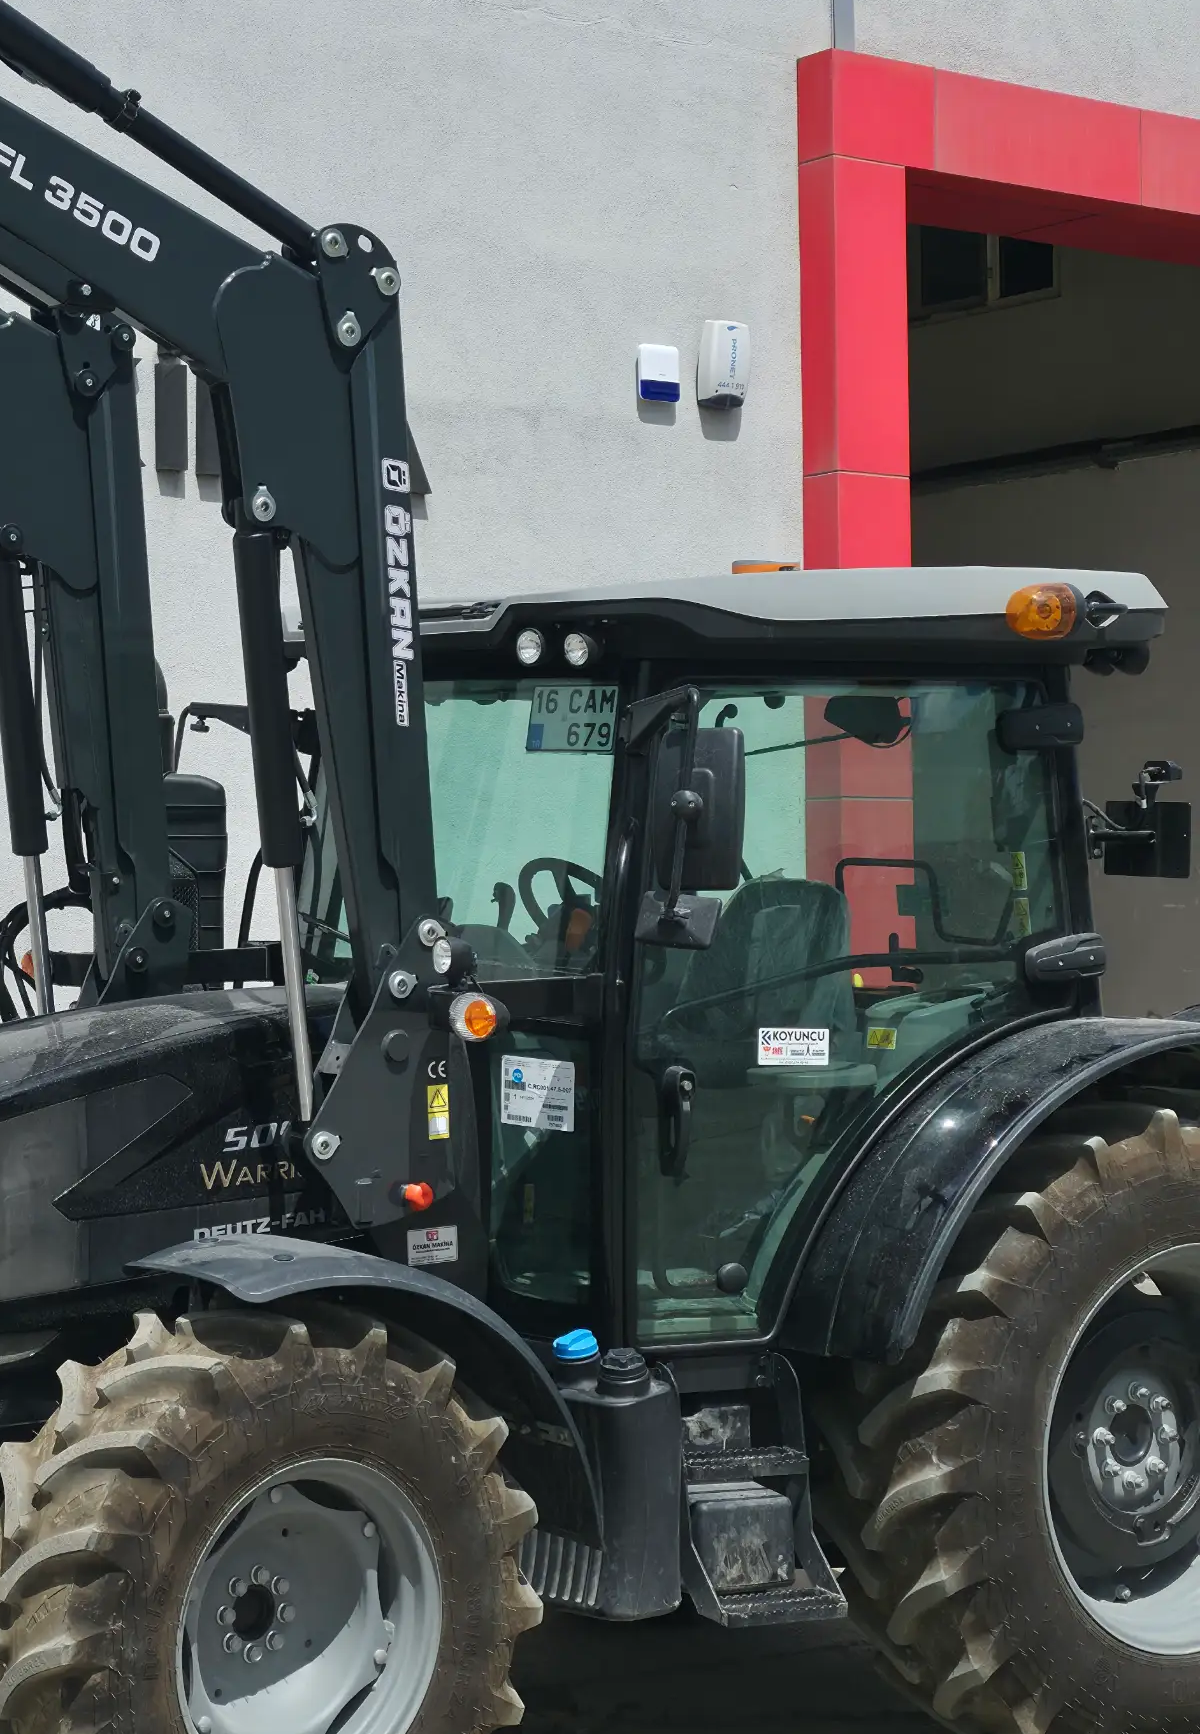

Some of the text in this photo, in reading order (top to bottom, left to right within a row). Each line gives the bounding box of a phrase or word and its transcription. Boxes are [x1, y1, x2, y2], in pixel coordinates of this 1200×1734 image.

[44, 175, 161, 262] 3500
[730, 338, 738, 380] PRONET
[385, 504, 415, 724] ÖZKAN Makina
[537, 689, 617, 714] 16 CAM
[566, 722, 612, 747] 679
[772, 1030, 825, 1042] KOYUNCU
[200, 1159, 303, 1190] WARRI
[193, 1209, 326, 1242] DEUTZ-FAH
